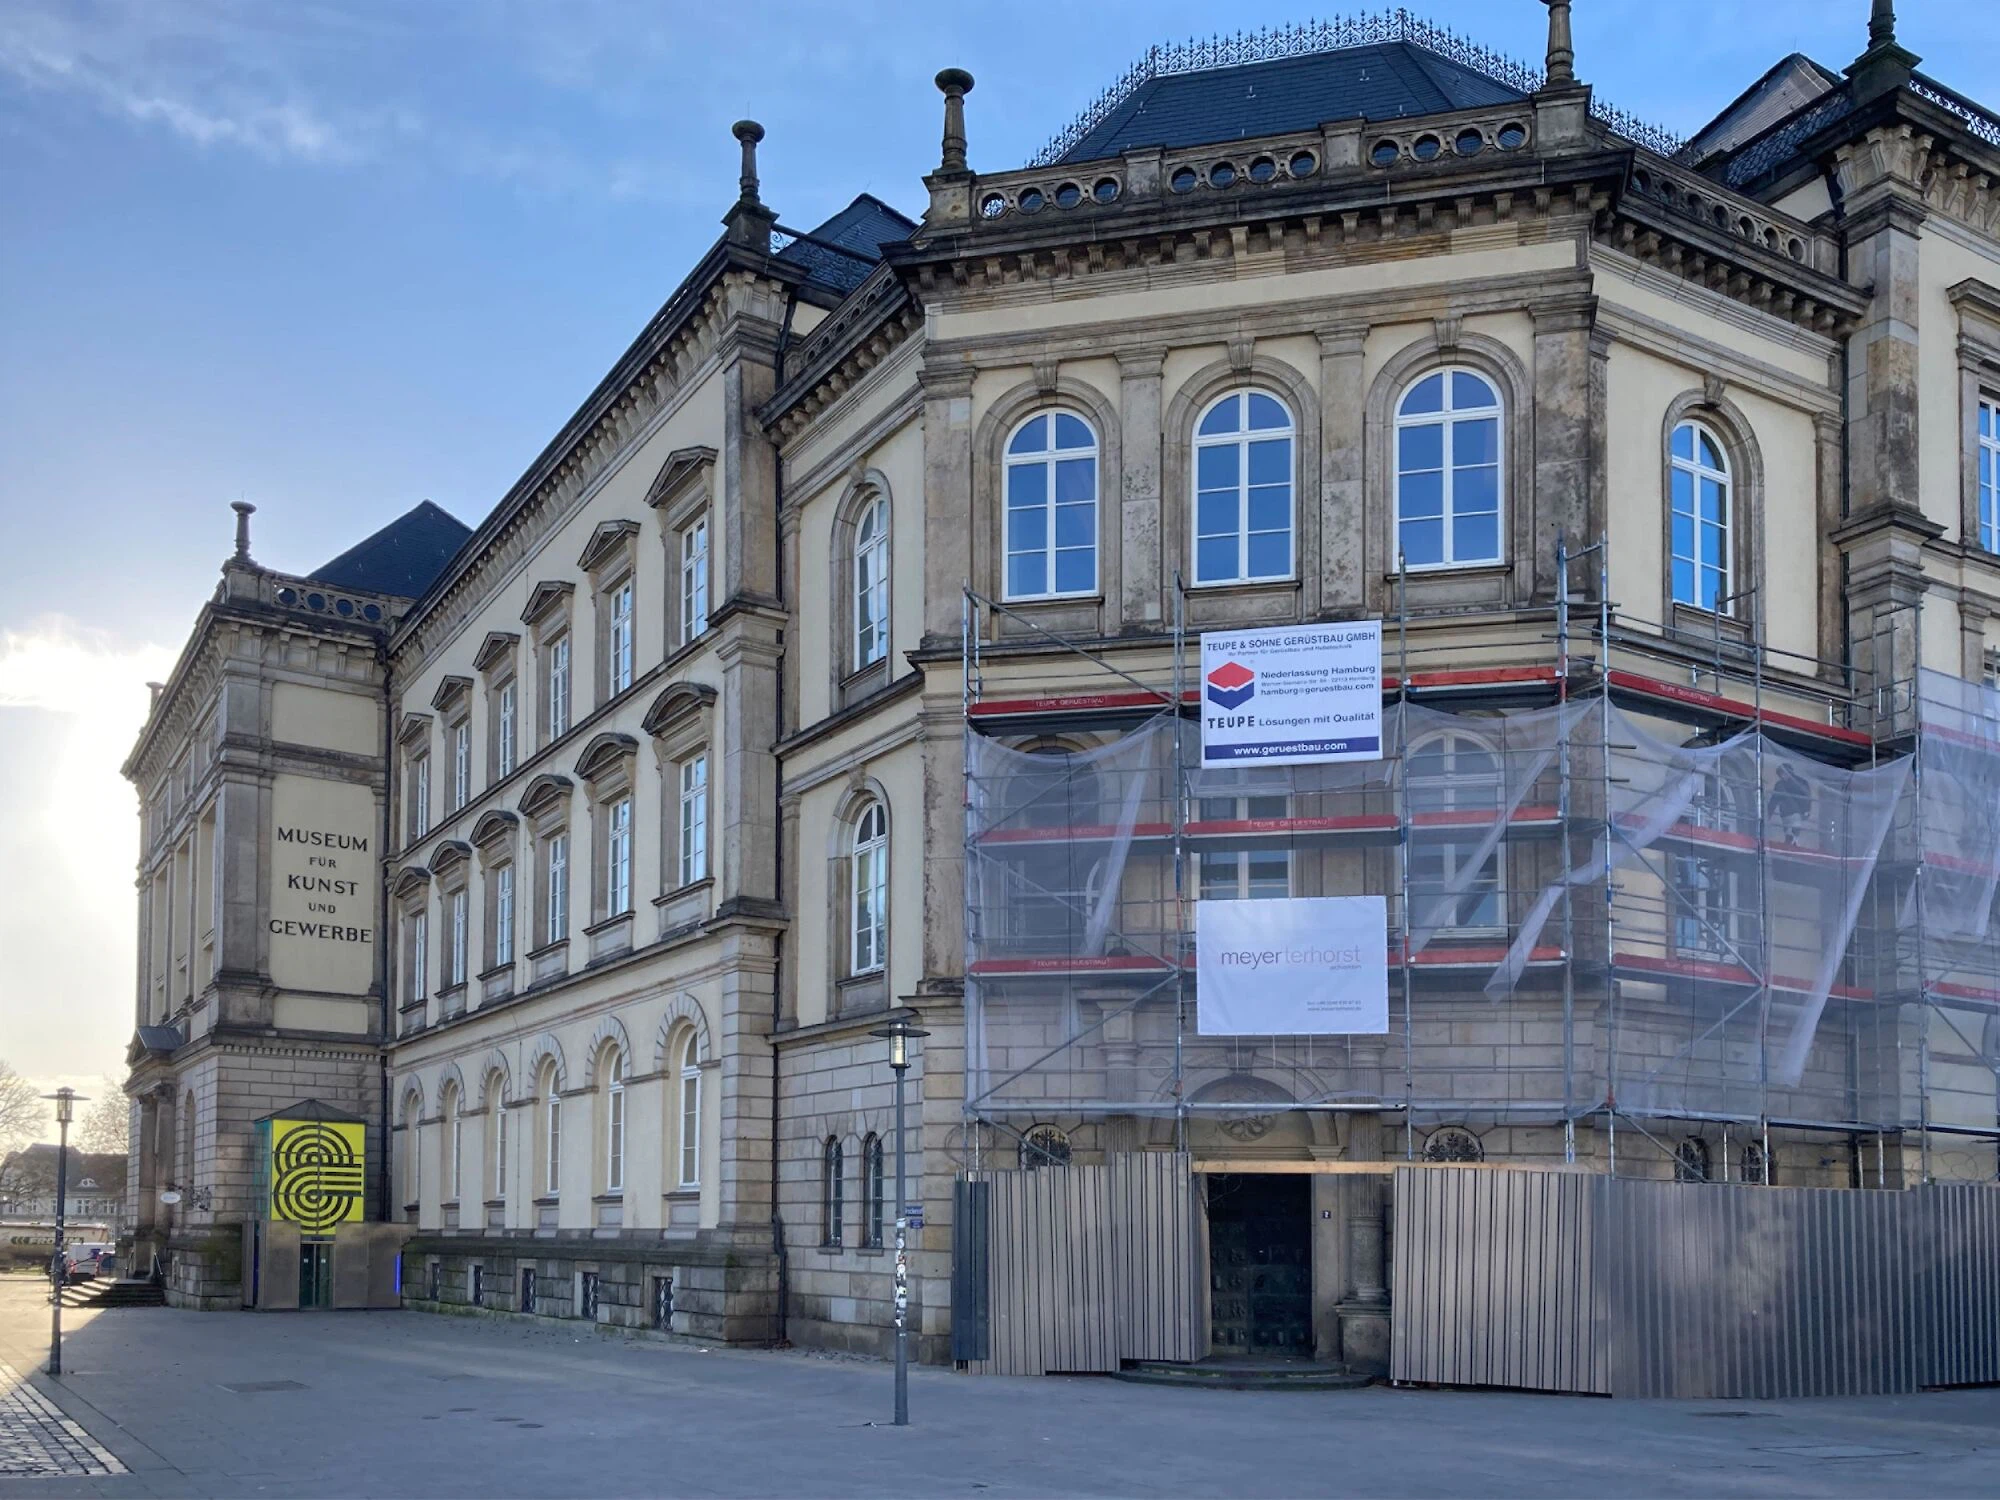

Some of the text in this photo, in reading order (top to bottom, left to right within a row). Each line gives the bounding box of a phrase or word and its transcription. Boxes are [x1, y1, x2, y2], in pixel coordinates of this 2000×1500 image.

[1207, 632, 1376, 651] TEUPE & SÖHNE GERÜSTBAU GMBH
[1261, 665, 1376, 679] Niederlassung Hamburg
[1208, 715, 1255, 729] TEUPE
[1259, 711, 1375, 727] Lösungen mit Qualität
[1234, 741, 1347, 756] www.geruestbau.com
[277, 826, 368, 852] MUSEUM
[309, 856, 337, 868] FÜR
[288, 874, 359, 896] KUNST
[308, 902, 336, 914] UND
[269, 919, 373, 943] GEWERBE
